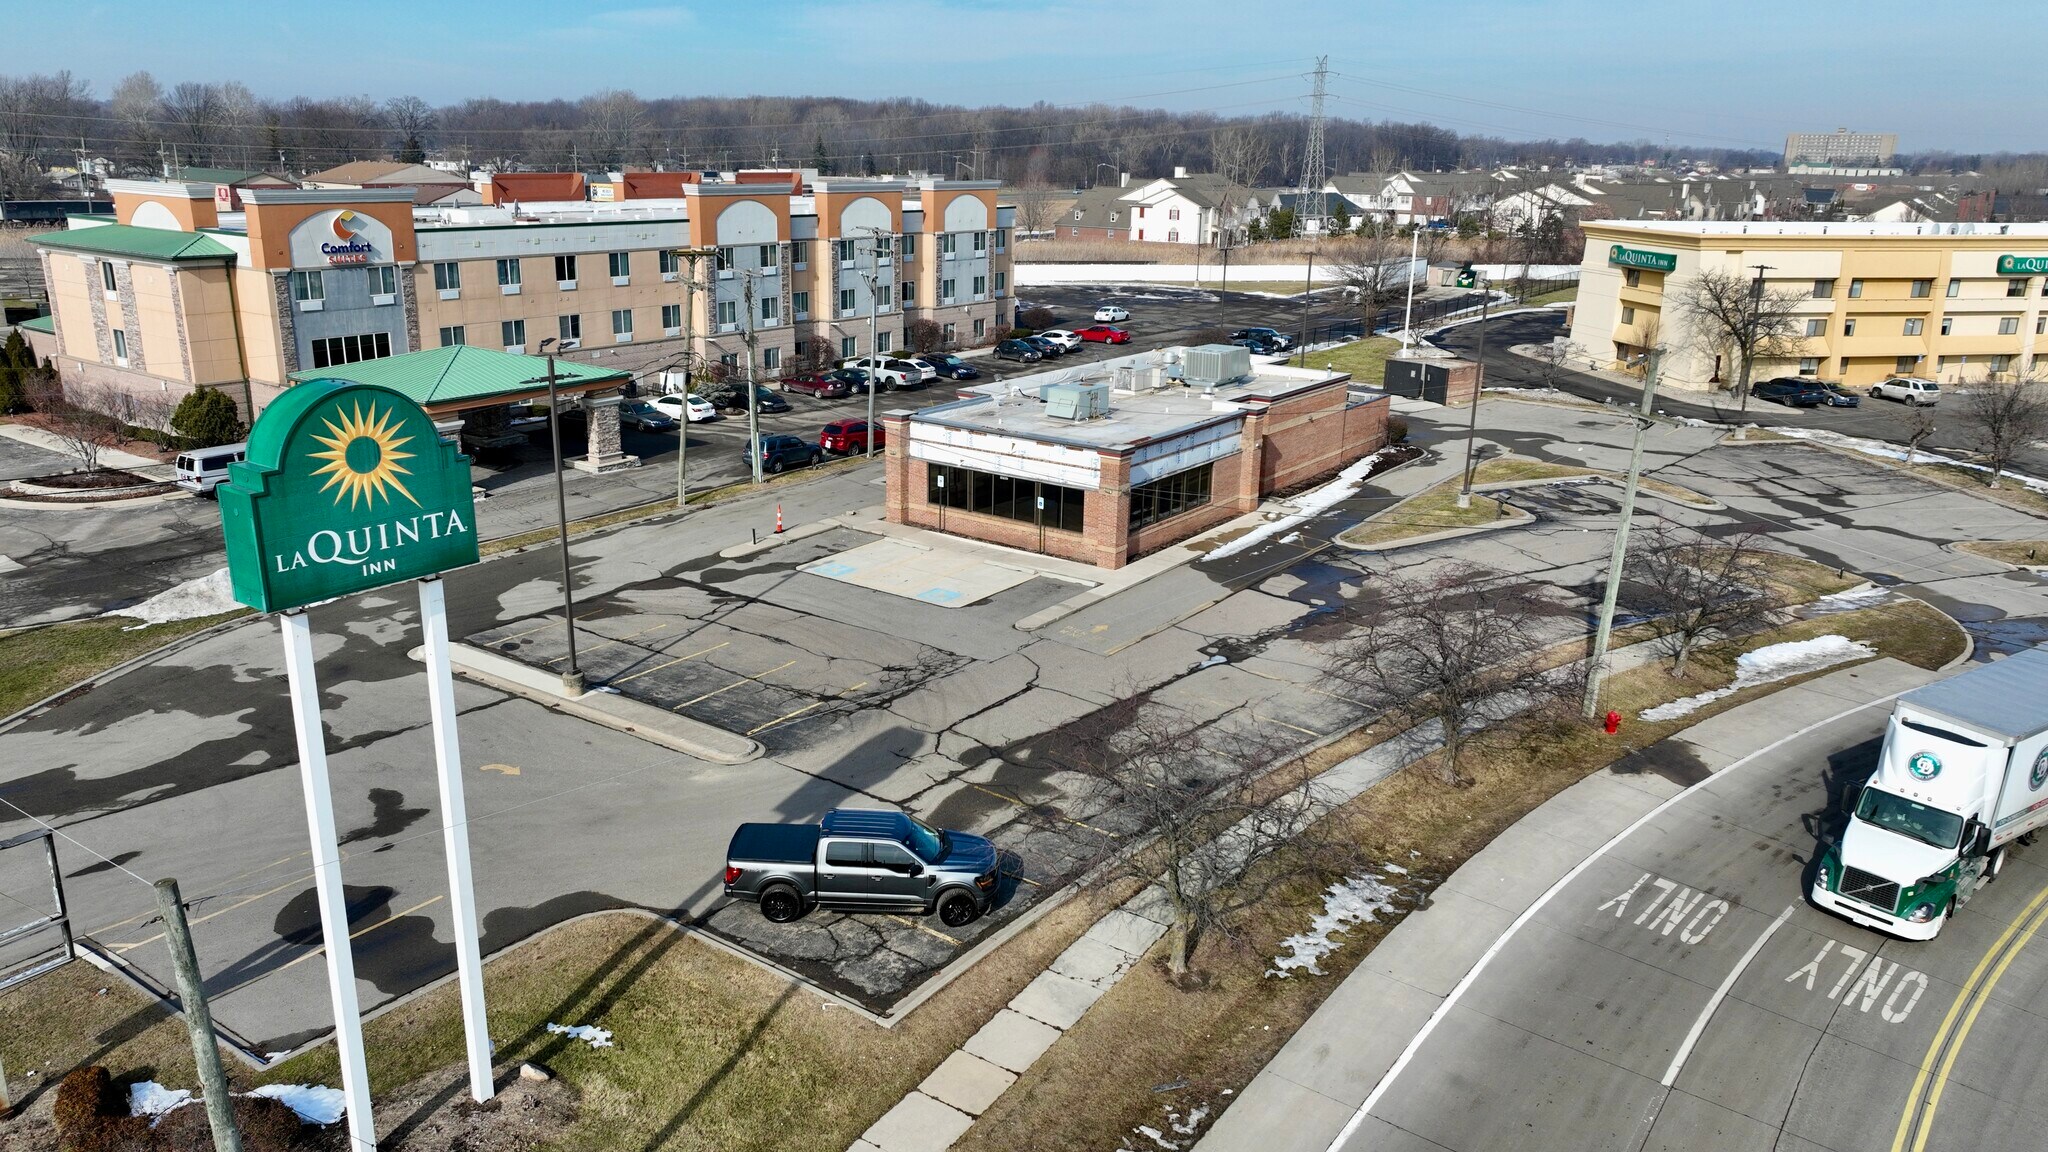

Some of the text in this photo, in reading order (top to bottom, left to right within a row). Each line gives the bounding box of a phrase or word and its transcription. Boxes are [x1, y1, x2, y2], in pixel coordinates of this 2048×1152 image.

[321, 241, 372, 254] Comfort
[1625, 250, 1657, 265] QUINTA
[1657, 259, 1669, 267] INN
[275, 508, 468, 573] LA QUINTA
[362, 558, 396, 577] INN
[1597, 873, 1729, 945] ONLY
[1784, 939, 1929, 1024] ONLY
